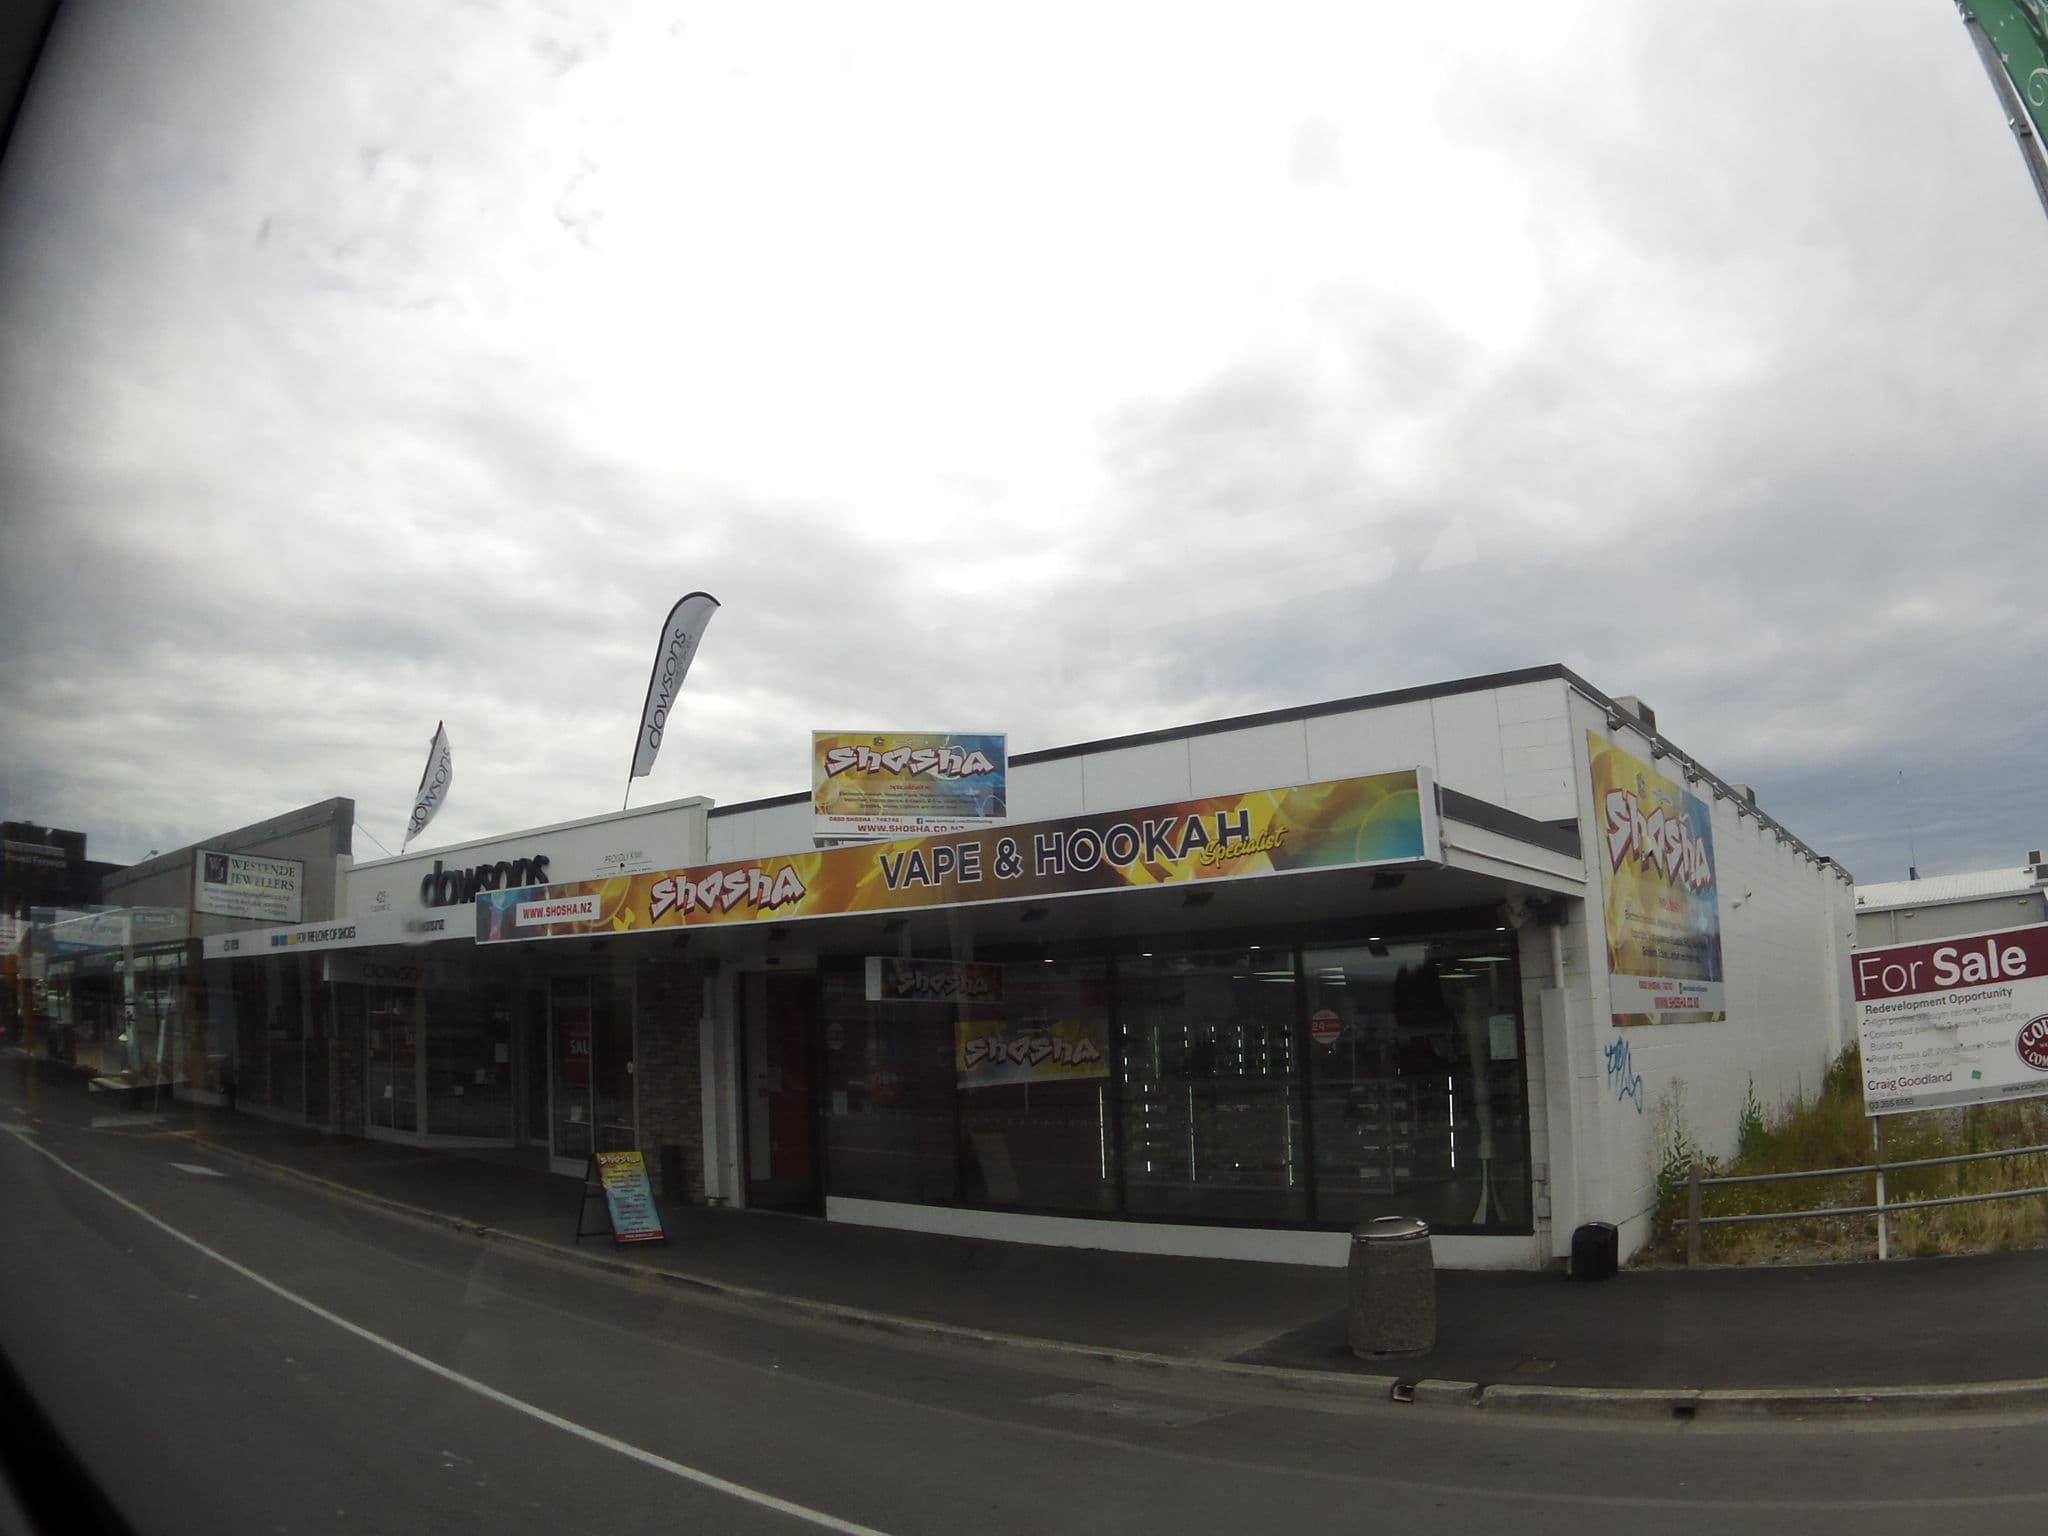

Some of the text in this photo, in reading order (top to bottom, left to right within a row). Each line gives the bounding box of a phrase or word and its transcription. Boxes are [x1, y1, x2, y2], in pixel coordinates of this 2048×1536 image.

[648, 629, 686, 749] dowsons
[879, 809, 1251, 891] VAPE & HOOKAH
[1199, 827, 1288, 868] Specialist
[231, 858, 295, 877] WESTENDE
[231, 872, 295, 891] JEWELLERS
[522, 901, 593, 920] WWW.SHOSHA.NZ
[1858, 939, 2027, 995] For Sale
[1865, 987, 2013, 1014] Redevelopment Opportunity
[1868, 1071, 1953, 1091] Craig Goodland
